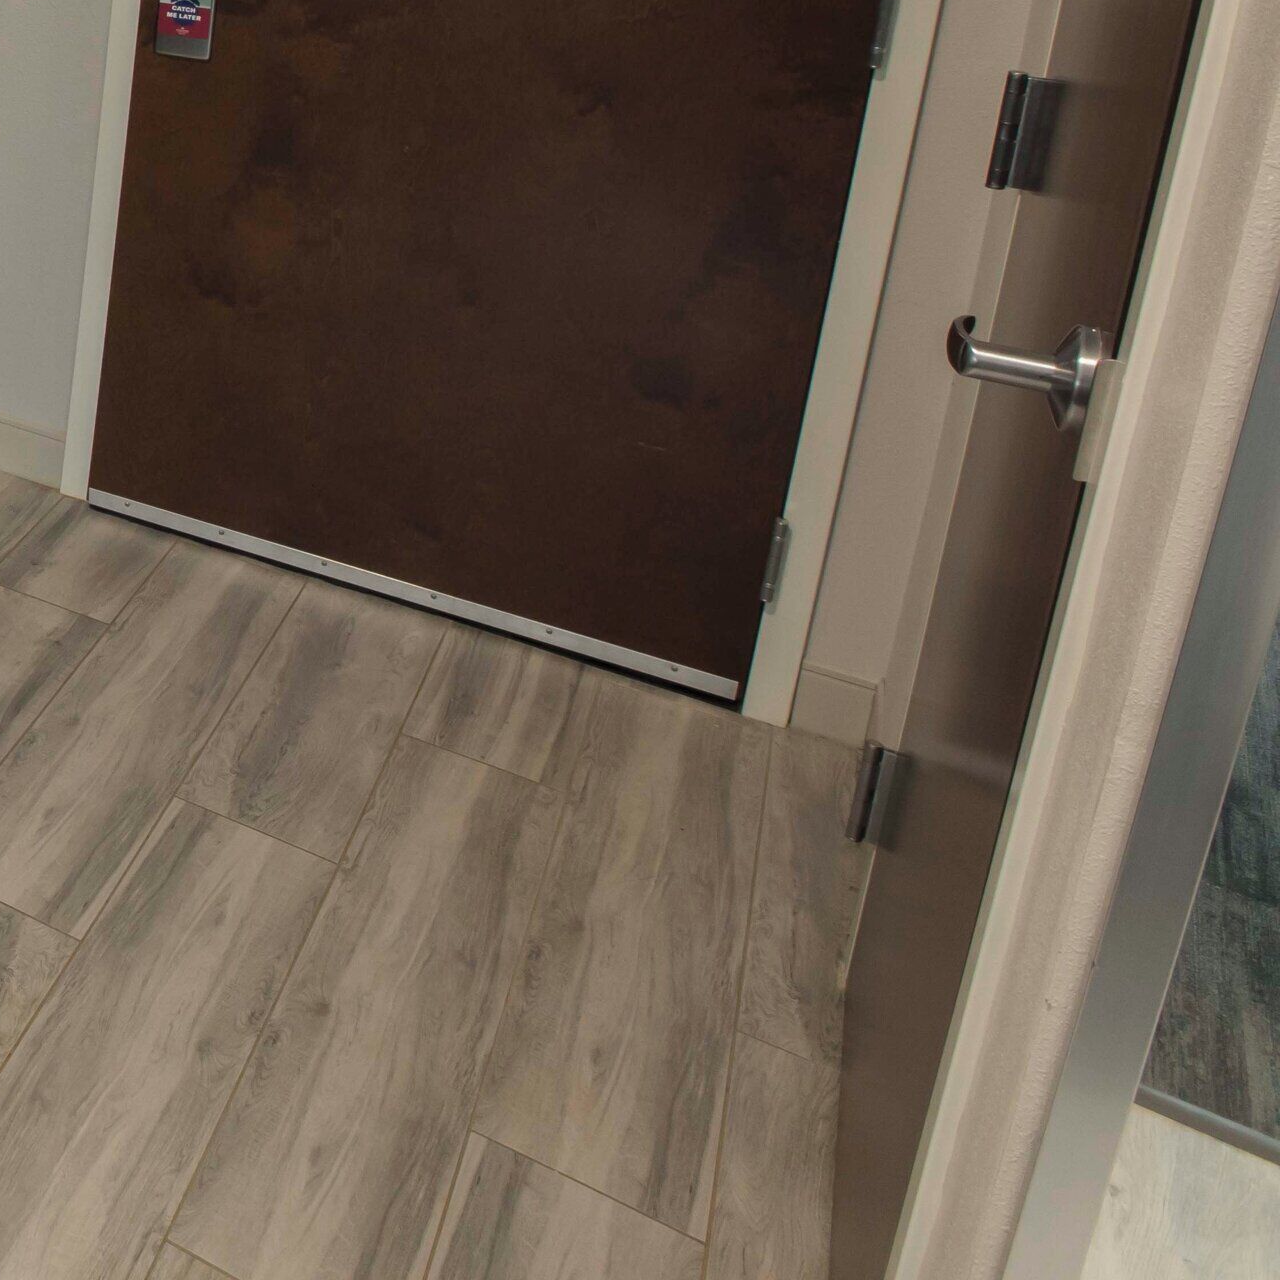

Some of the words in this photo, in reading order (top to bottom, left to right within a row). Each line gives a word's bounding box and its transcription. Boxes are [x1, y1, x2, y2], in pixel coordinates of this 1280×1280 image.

[171, 5, 196, 13] CATCH
[166, 11, 177, 19] ME
[178, 13, 202, 22] LATER
